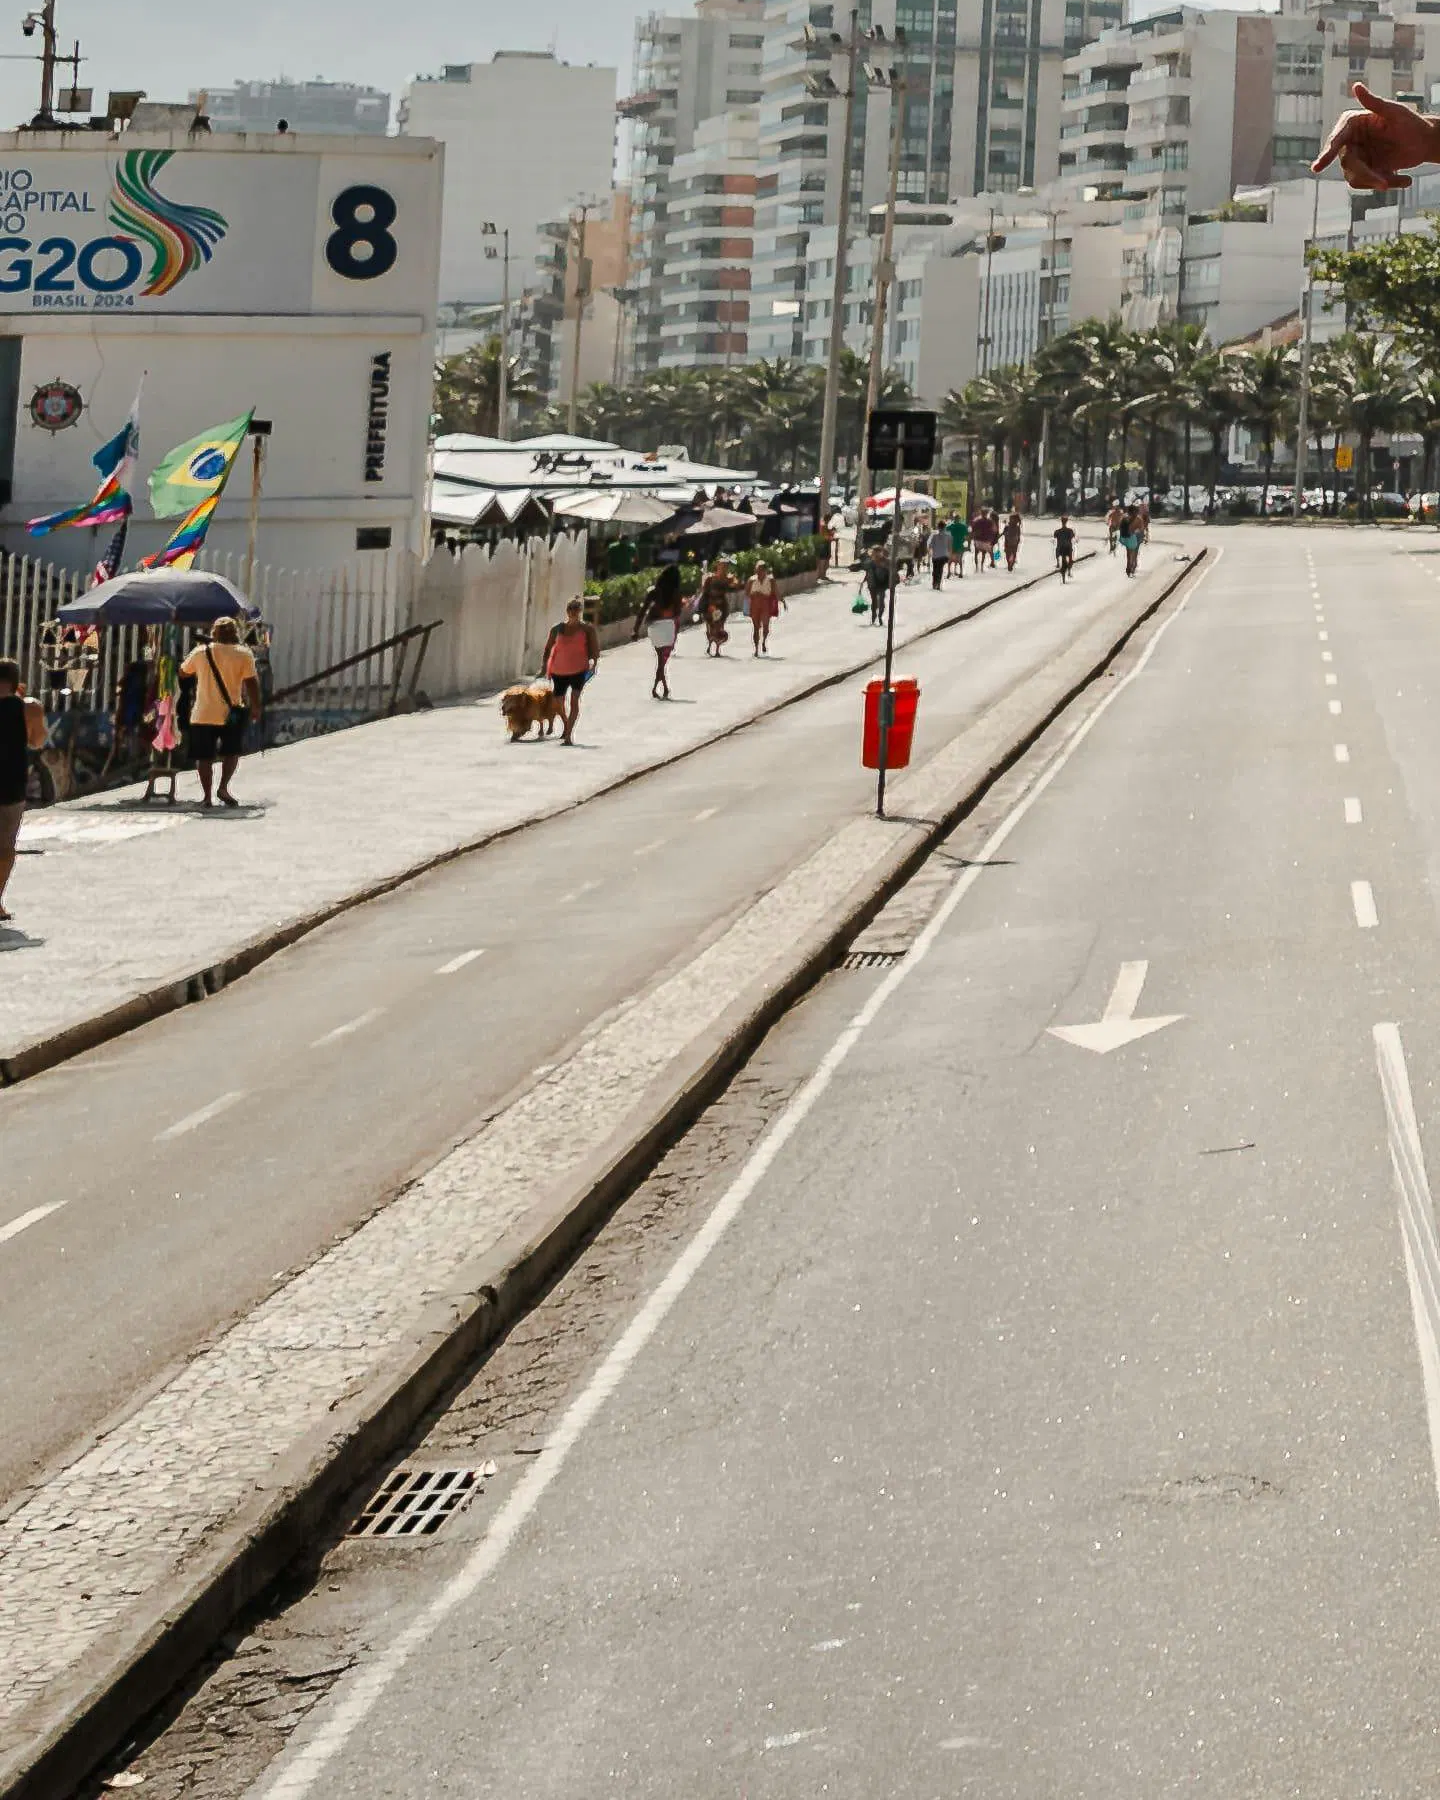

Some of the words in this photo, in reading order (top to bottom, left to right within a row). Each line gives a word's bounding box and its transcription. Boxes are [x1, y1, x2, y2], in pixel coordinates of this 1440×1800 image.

[0, 169, 33, 191] IO
[0, 191, 96, 212] APITAL
[325, 184, 398, 280] 8
[32, 294, 88, 307] BRASIL
[93, 294, 134, 307] 2024
[364, 350, 392, 482] PREFEITURA
